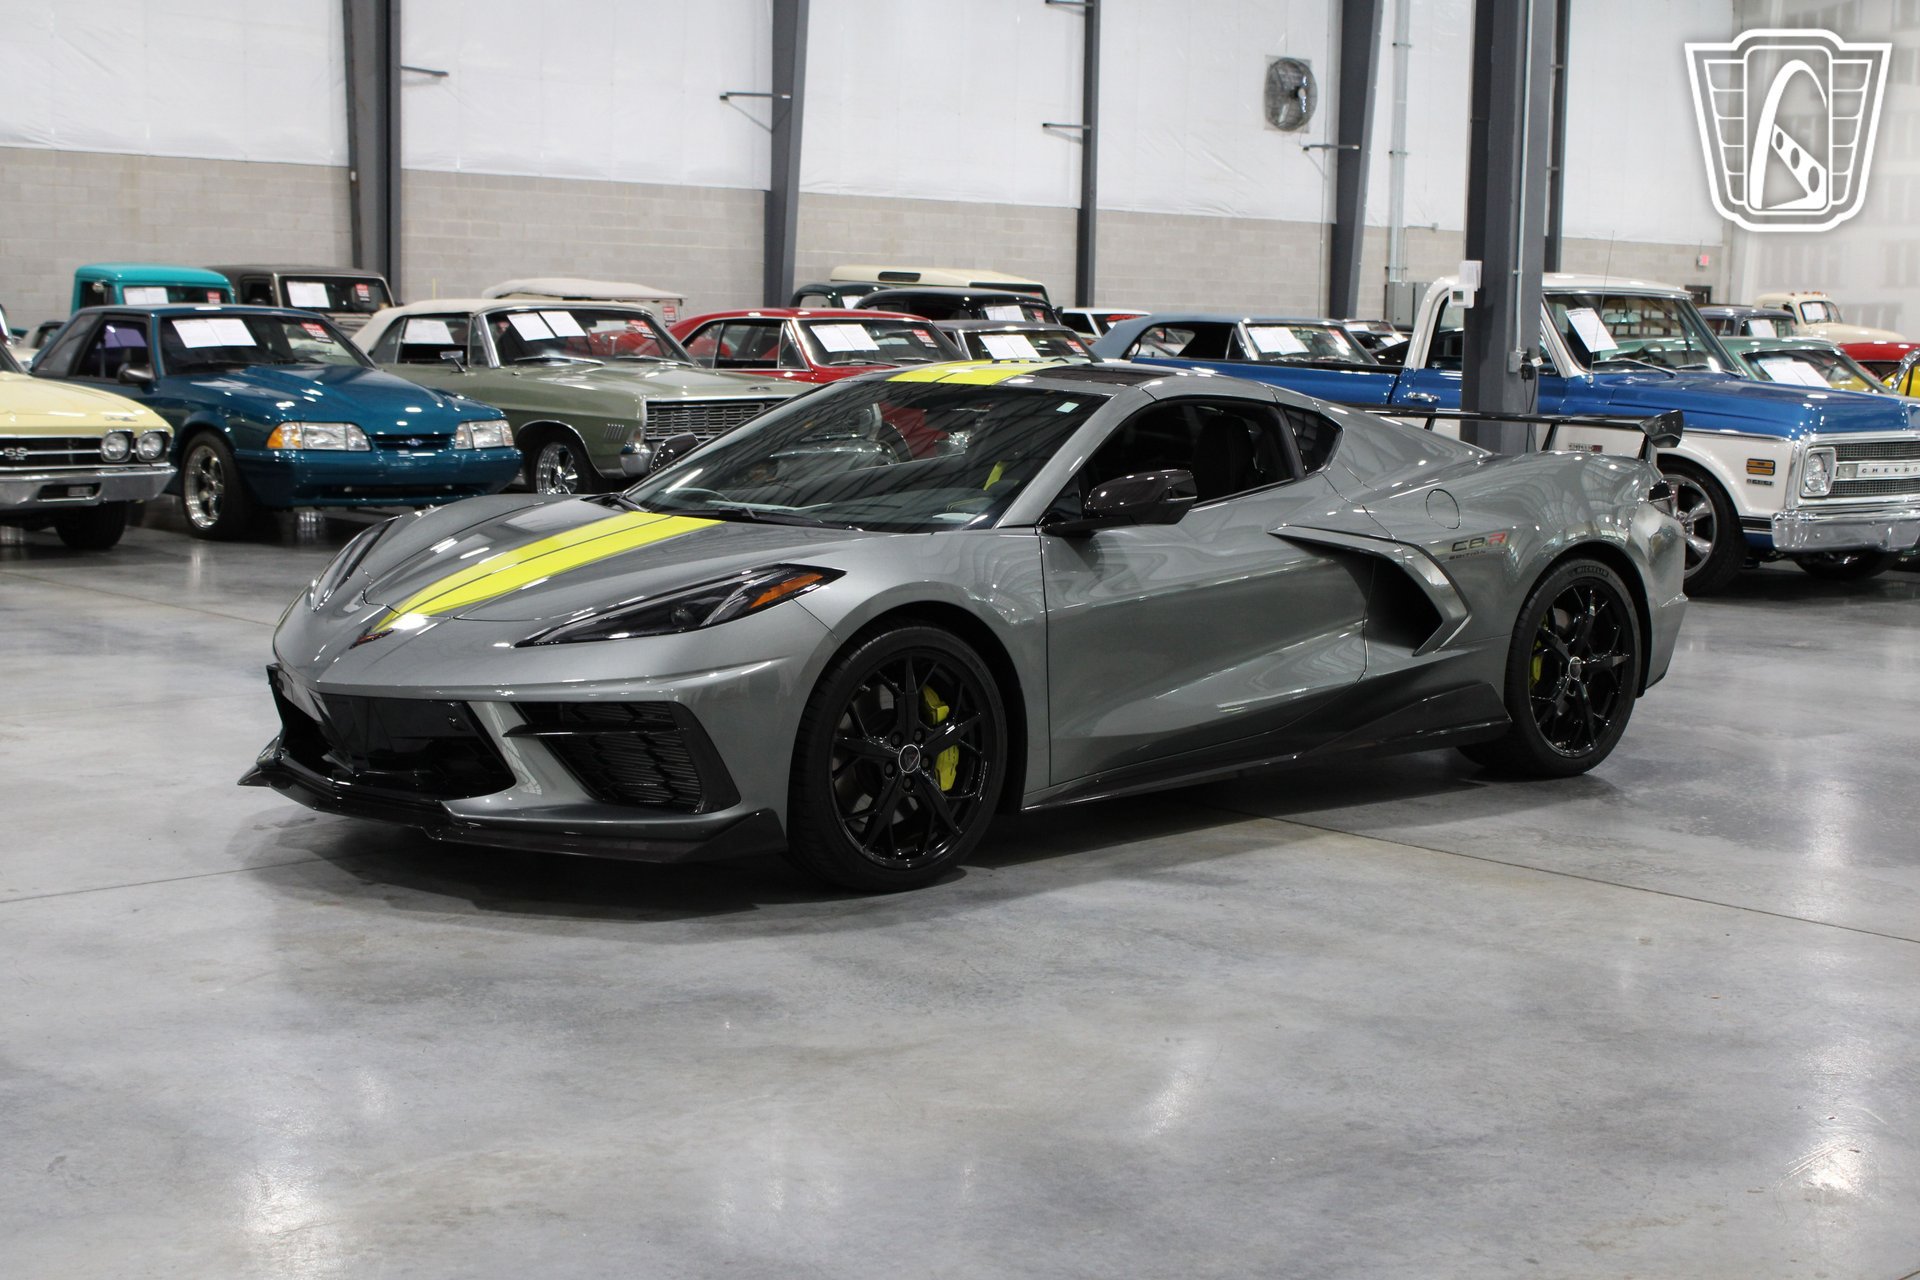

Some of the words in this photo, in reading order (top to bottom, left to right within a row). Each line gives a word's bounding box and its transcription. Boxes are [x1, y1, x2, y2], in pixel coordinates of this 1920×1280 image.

[4, 447, 28, 457] SS
[1861, 466, 1919, 474] CHEVRO
[1575, 565, 1610, 578] MICHELIN
